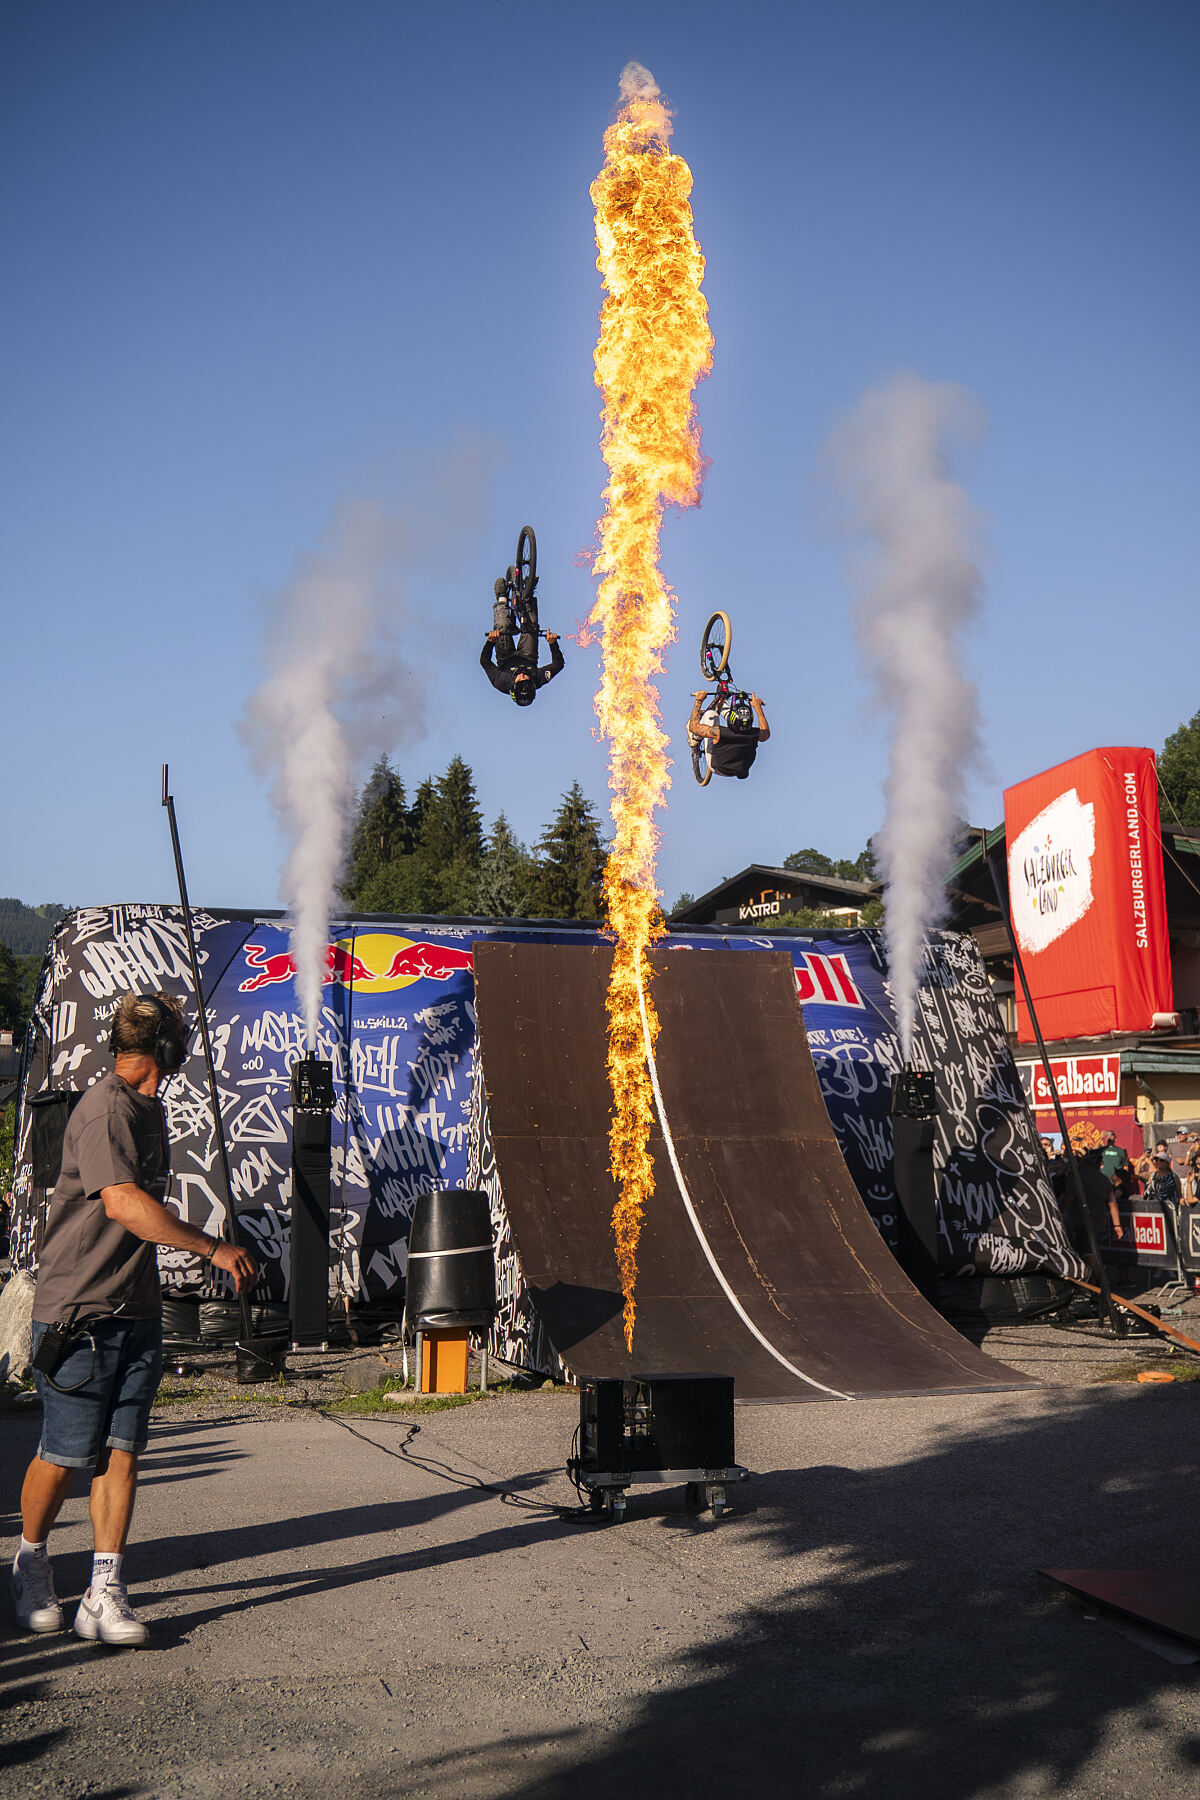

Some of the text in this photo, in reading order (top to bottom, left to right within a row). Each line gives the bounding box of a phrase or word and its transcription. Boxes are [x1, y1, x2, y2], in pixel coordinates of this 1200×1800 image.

[1023, 848, 1077, 896] SALZBURGER
[1123, 772, 1148, 949] SALZBURGERLAND.COM
[739, 901, 780, 920] KASTRO
[1039, 893, 1058, 915] LAND
[407, 1050, 459, 1101] DIRT
